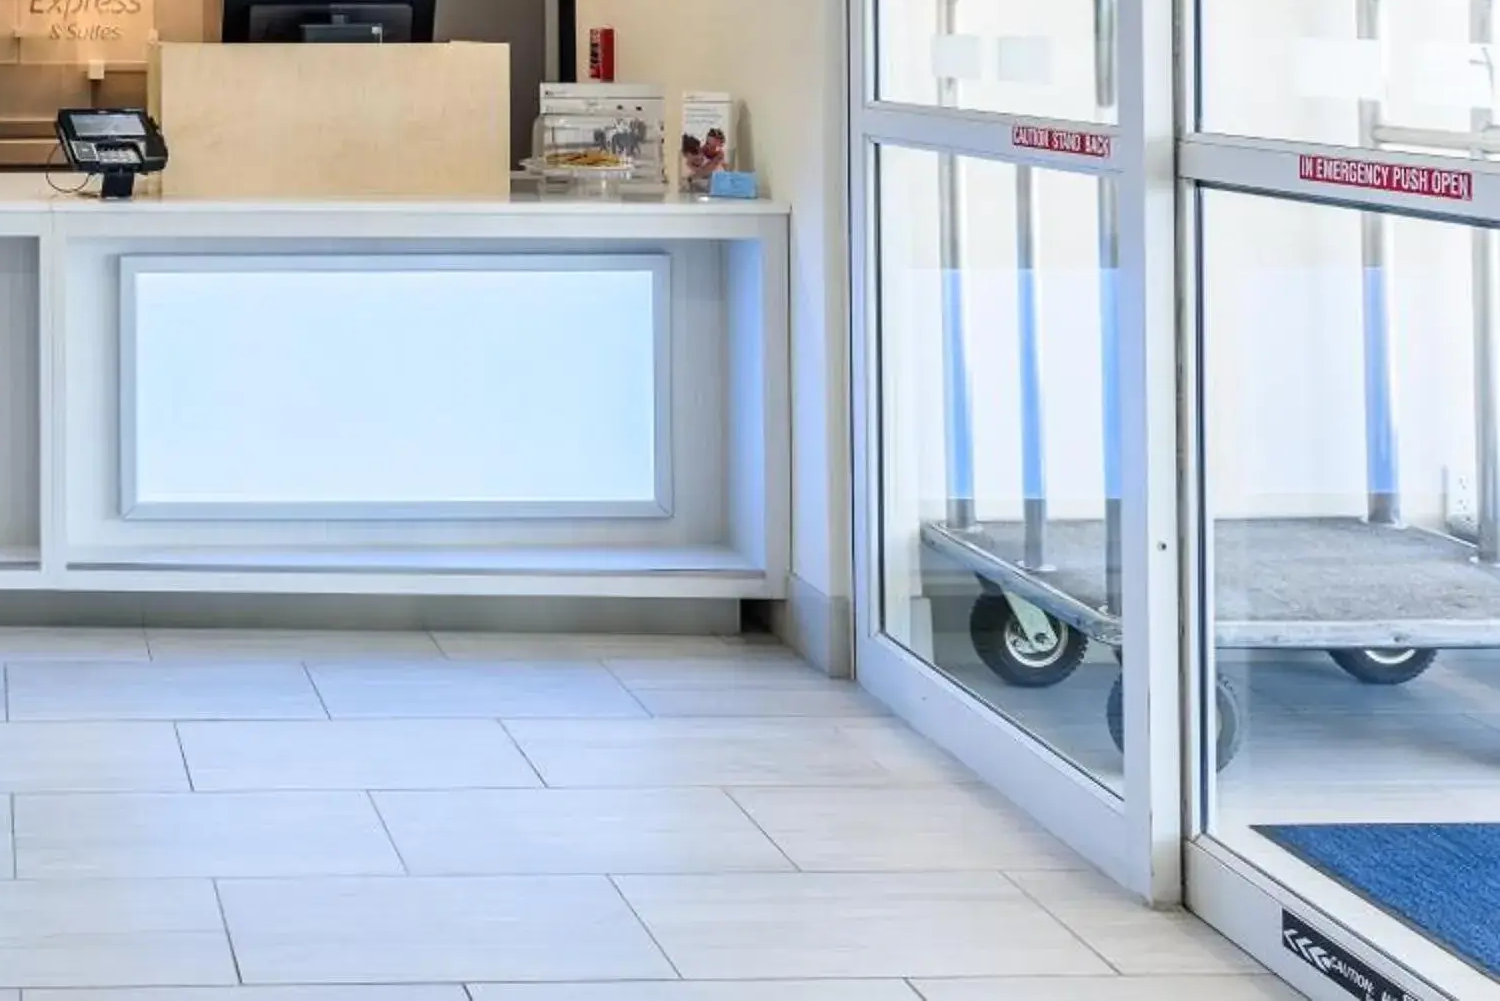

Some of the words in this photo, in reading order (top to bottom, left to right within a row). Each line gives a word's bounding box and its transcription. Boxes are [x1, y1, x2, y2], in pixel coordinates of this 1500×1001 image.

[49, 23, 61, 40] &
[66, 23, 121, 40] Suites
[1051, 130, 1082, 152] STAND
[1085, 134, 1110, 156] BACK
[1300, 155, 1313, 177] IN
[1316, 156, 1389, 187] EMERGENCY
[1393, 165, 1429, 192] PUSH
[1431, 169, 1470, 200] OPEN
